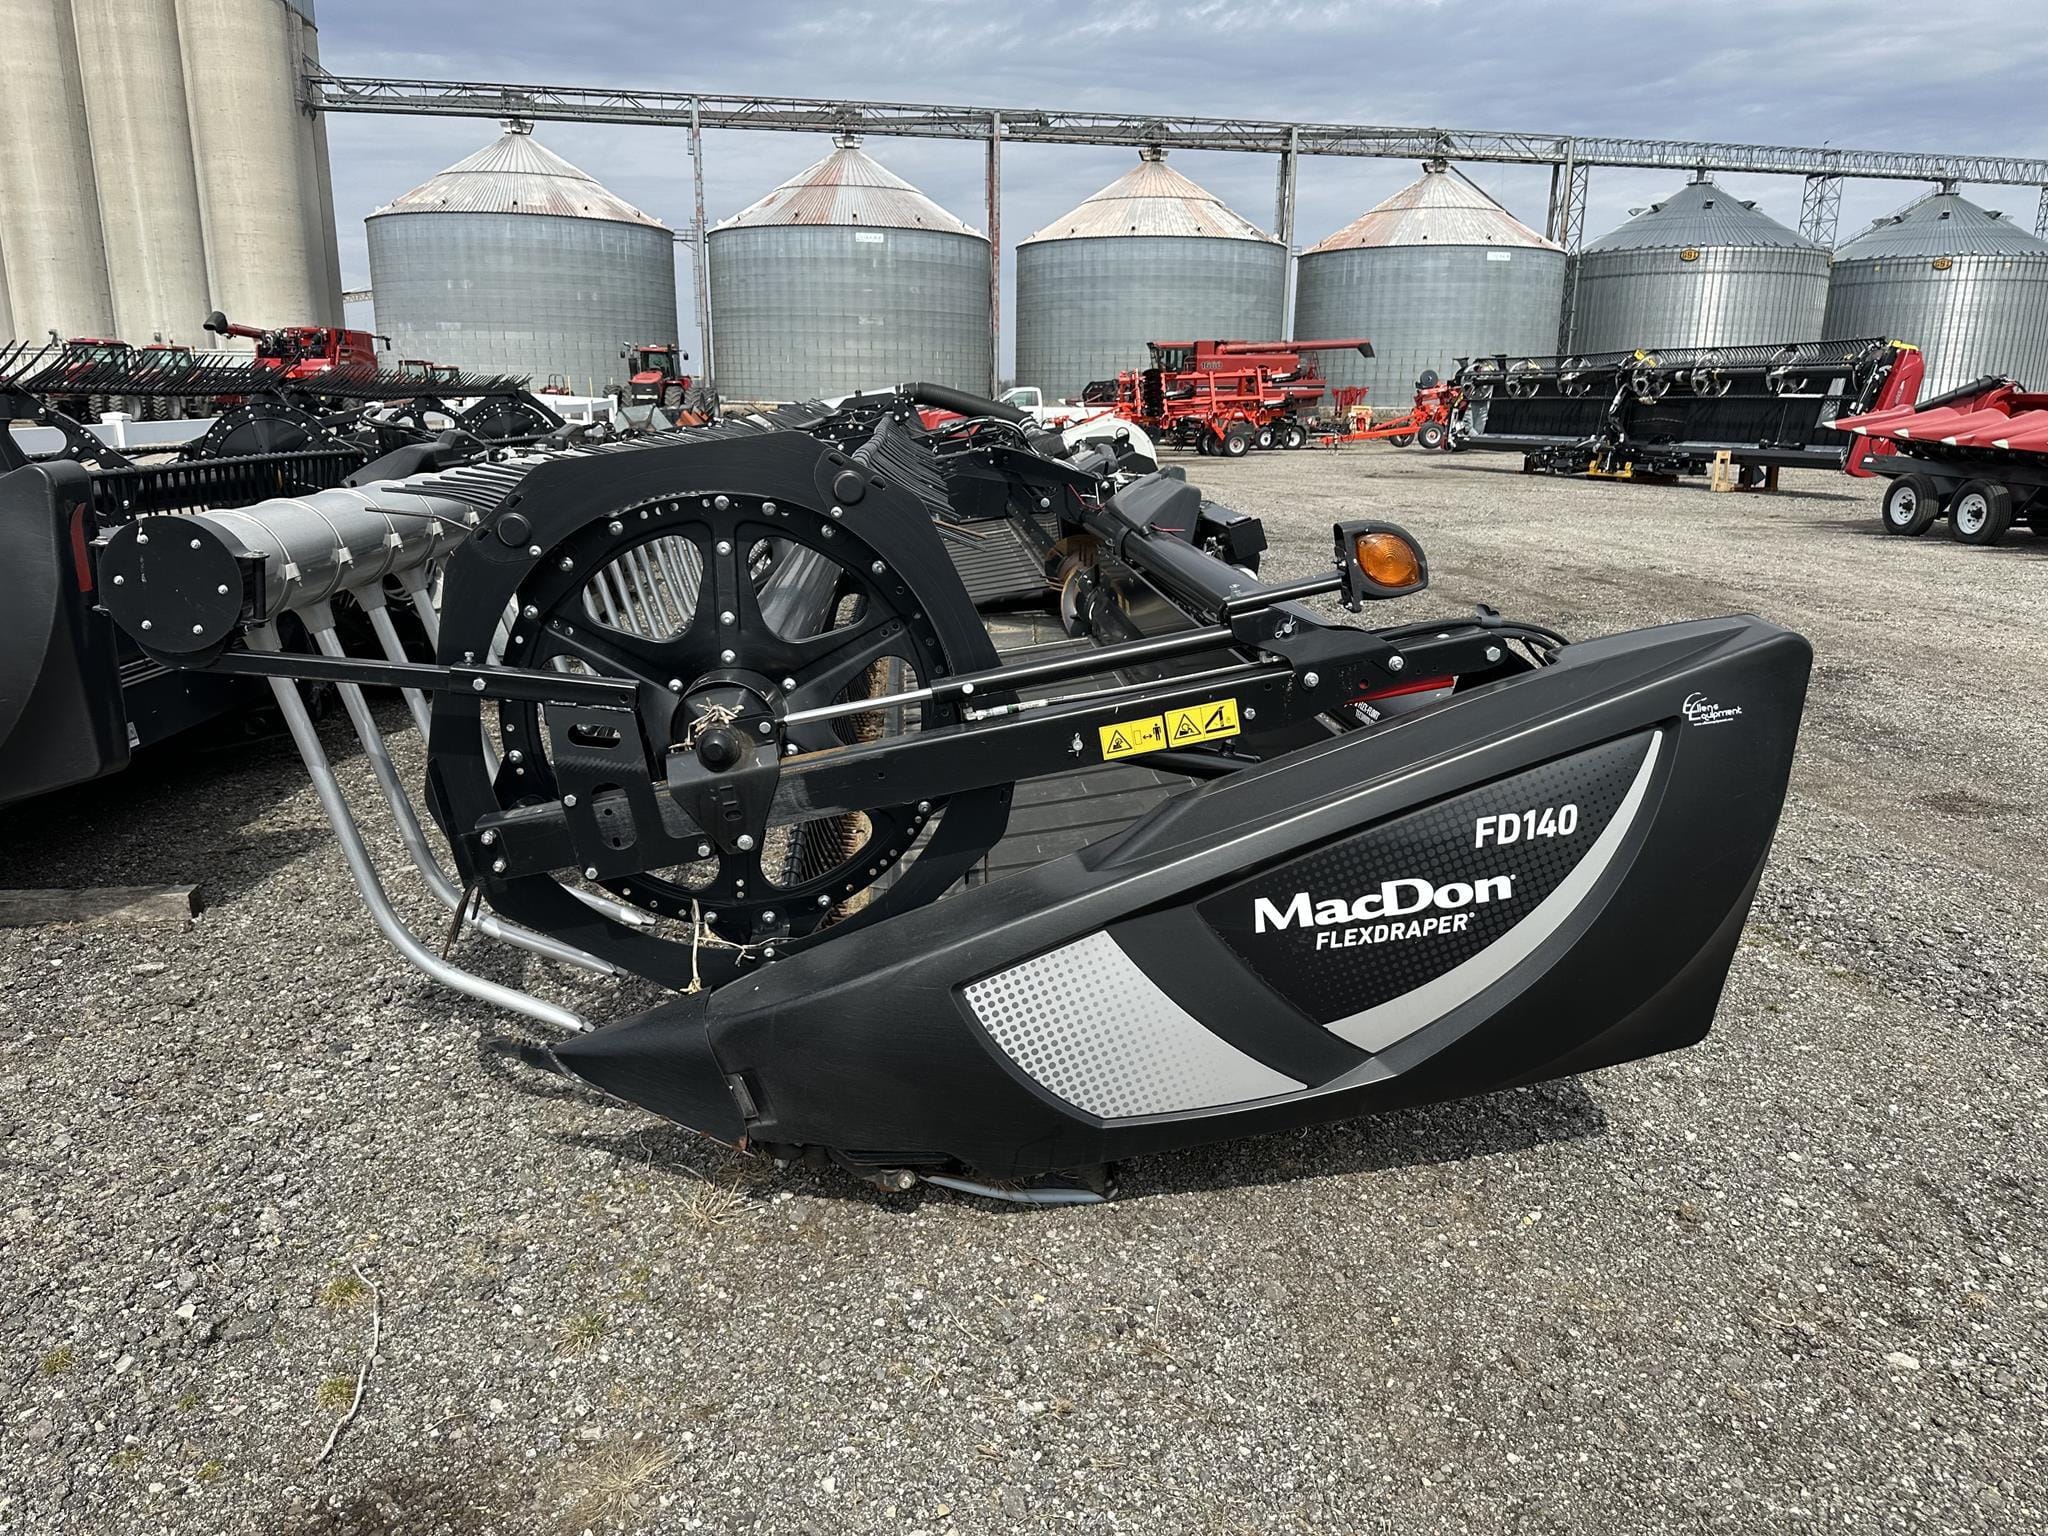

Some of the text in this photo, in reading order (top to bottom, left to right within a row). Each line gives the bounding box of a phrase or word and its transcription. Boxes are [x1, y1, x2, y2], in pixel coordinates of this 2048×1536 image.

[1689, 697, 1742, 721] Equipment
[1475, 804, 1578, 849] FD140
[1254, 875, 1512, 933] MacDon
[1316, 914, 1468, 950] FLEXDRAPER
